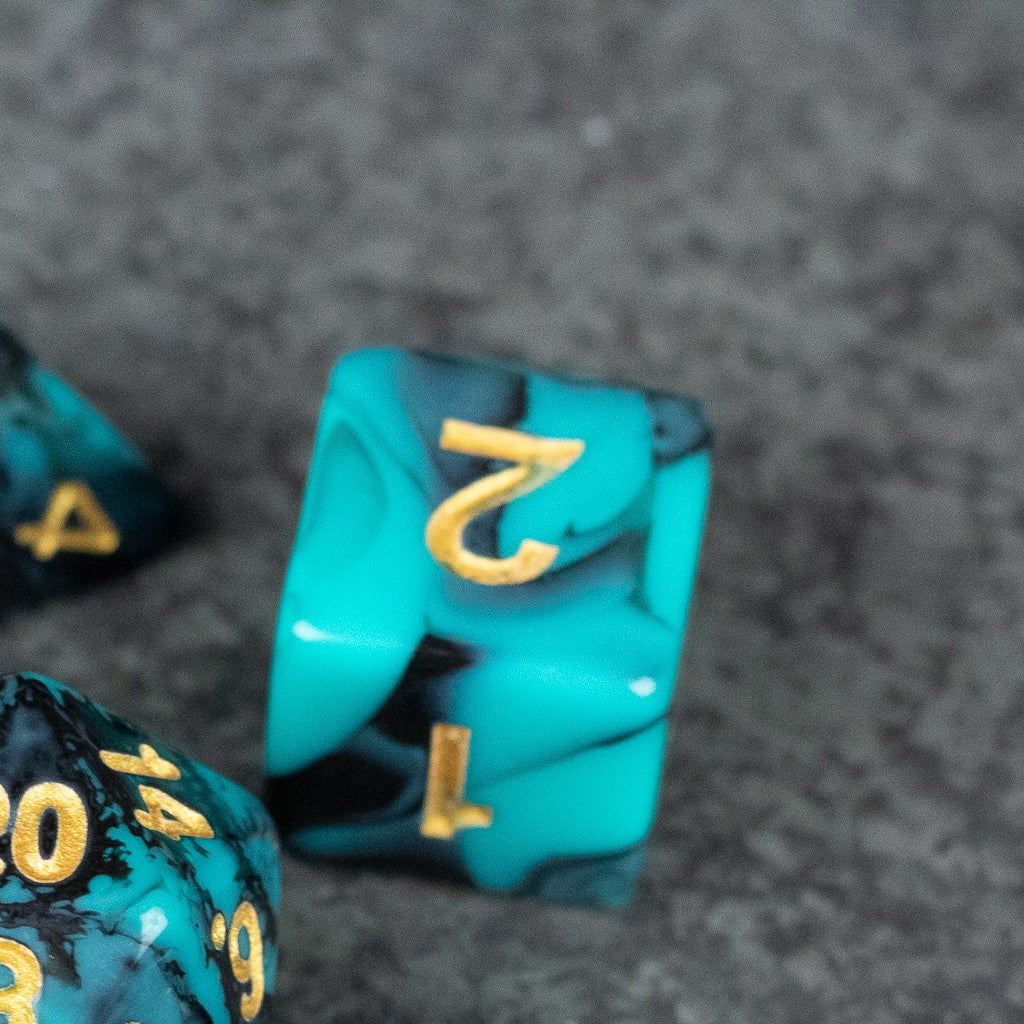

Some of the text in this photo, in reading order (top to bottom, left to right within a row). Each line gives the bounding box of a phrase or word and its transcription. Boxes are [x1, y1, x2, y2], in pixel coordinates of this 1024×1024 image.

[14, 480, 119, 560] 4
[425, 418, 584, 585] 2
[421, 722, 492, 839] 1
